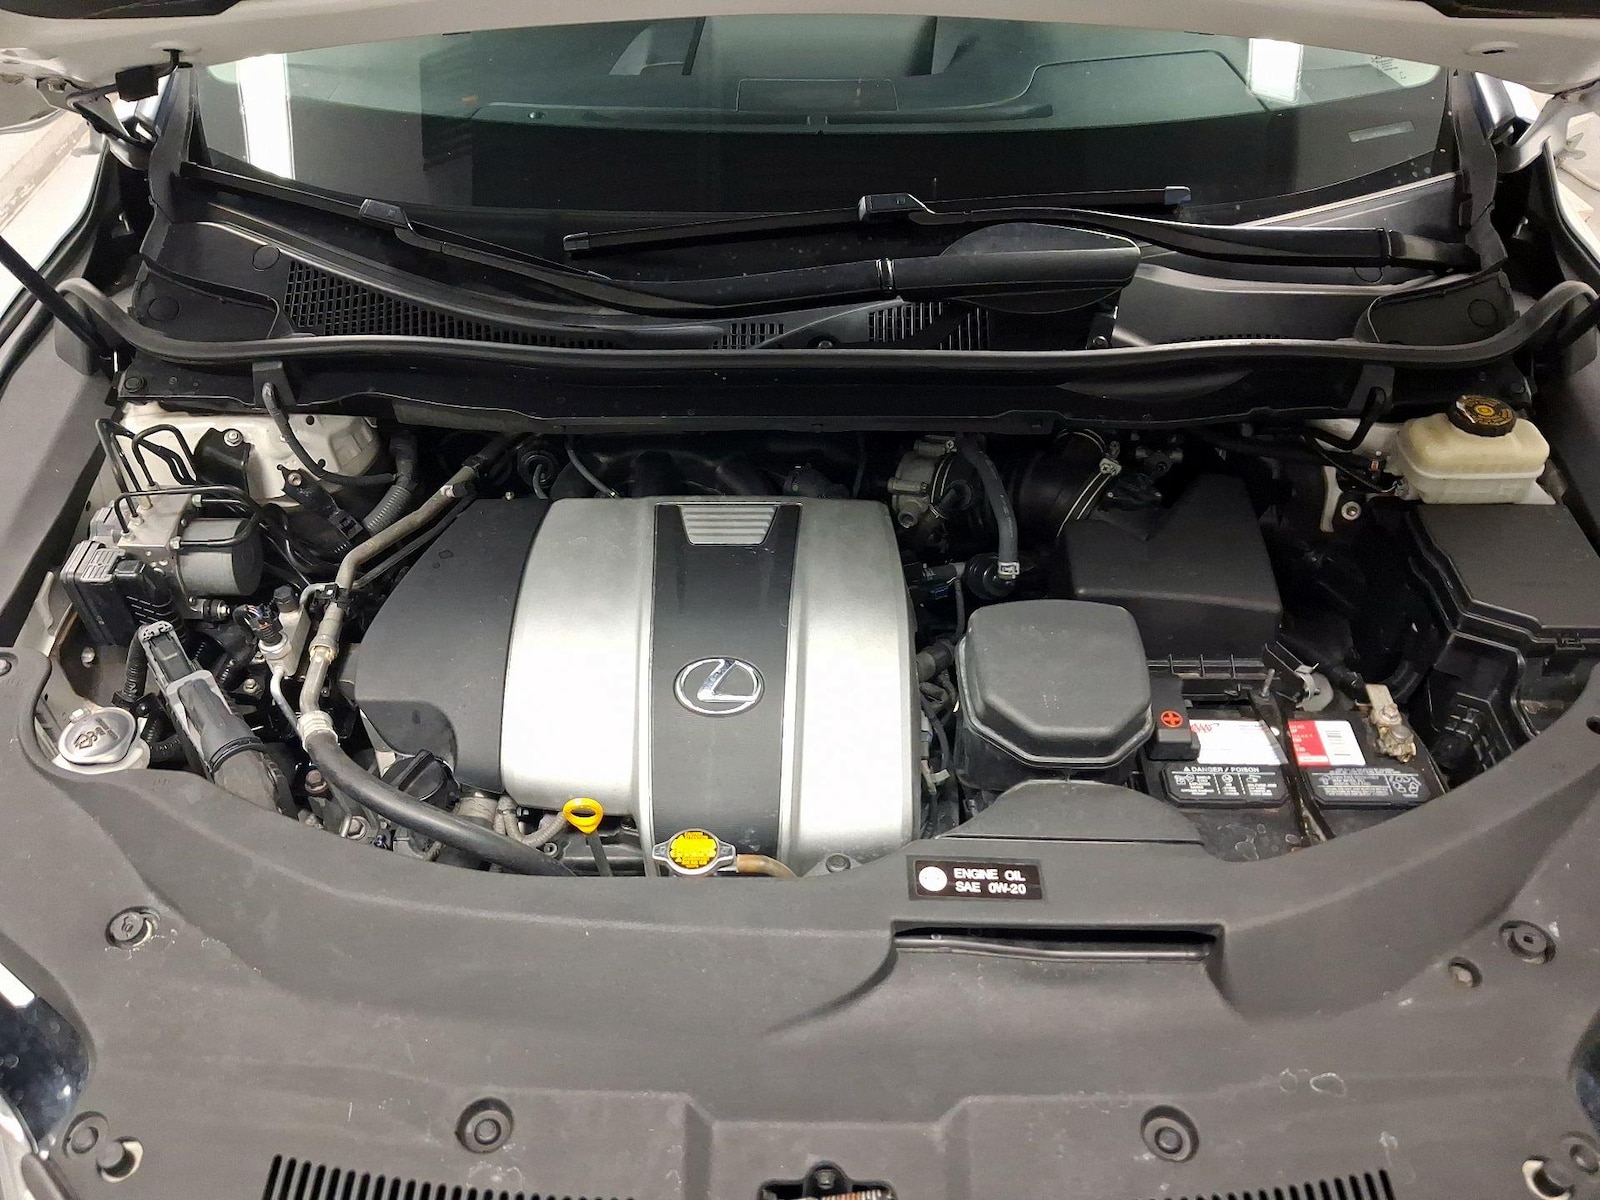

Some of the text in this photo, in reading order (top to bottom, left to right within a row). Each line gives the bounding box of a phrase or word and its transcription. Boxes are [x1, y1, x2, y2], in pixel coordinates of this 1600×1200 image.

[953, 868, 1026, 882] ENGINE OIL
[955, 882, 1027, 895] SAE 0W-20
